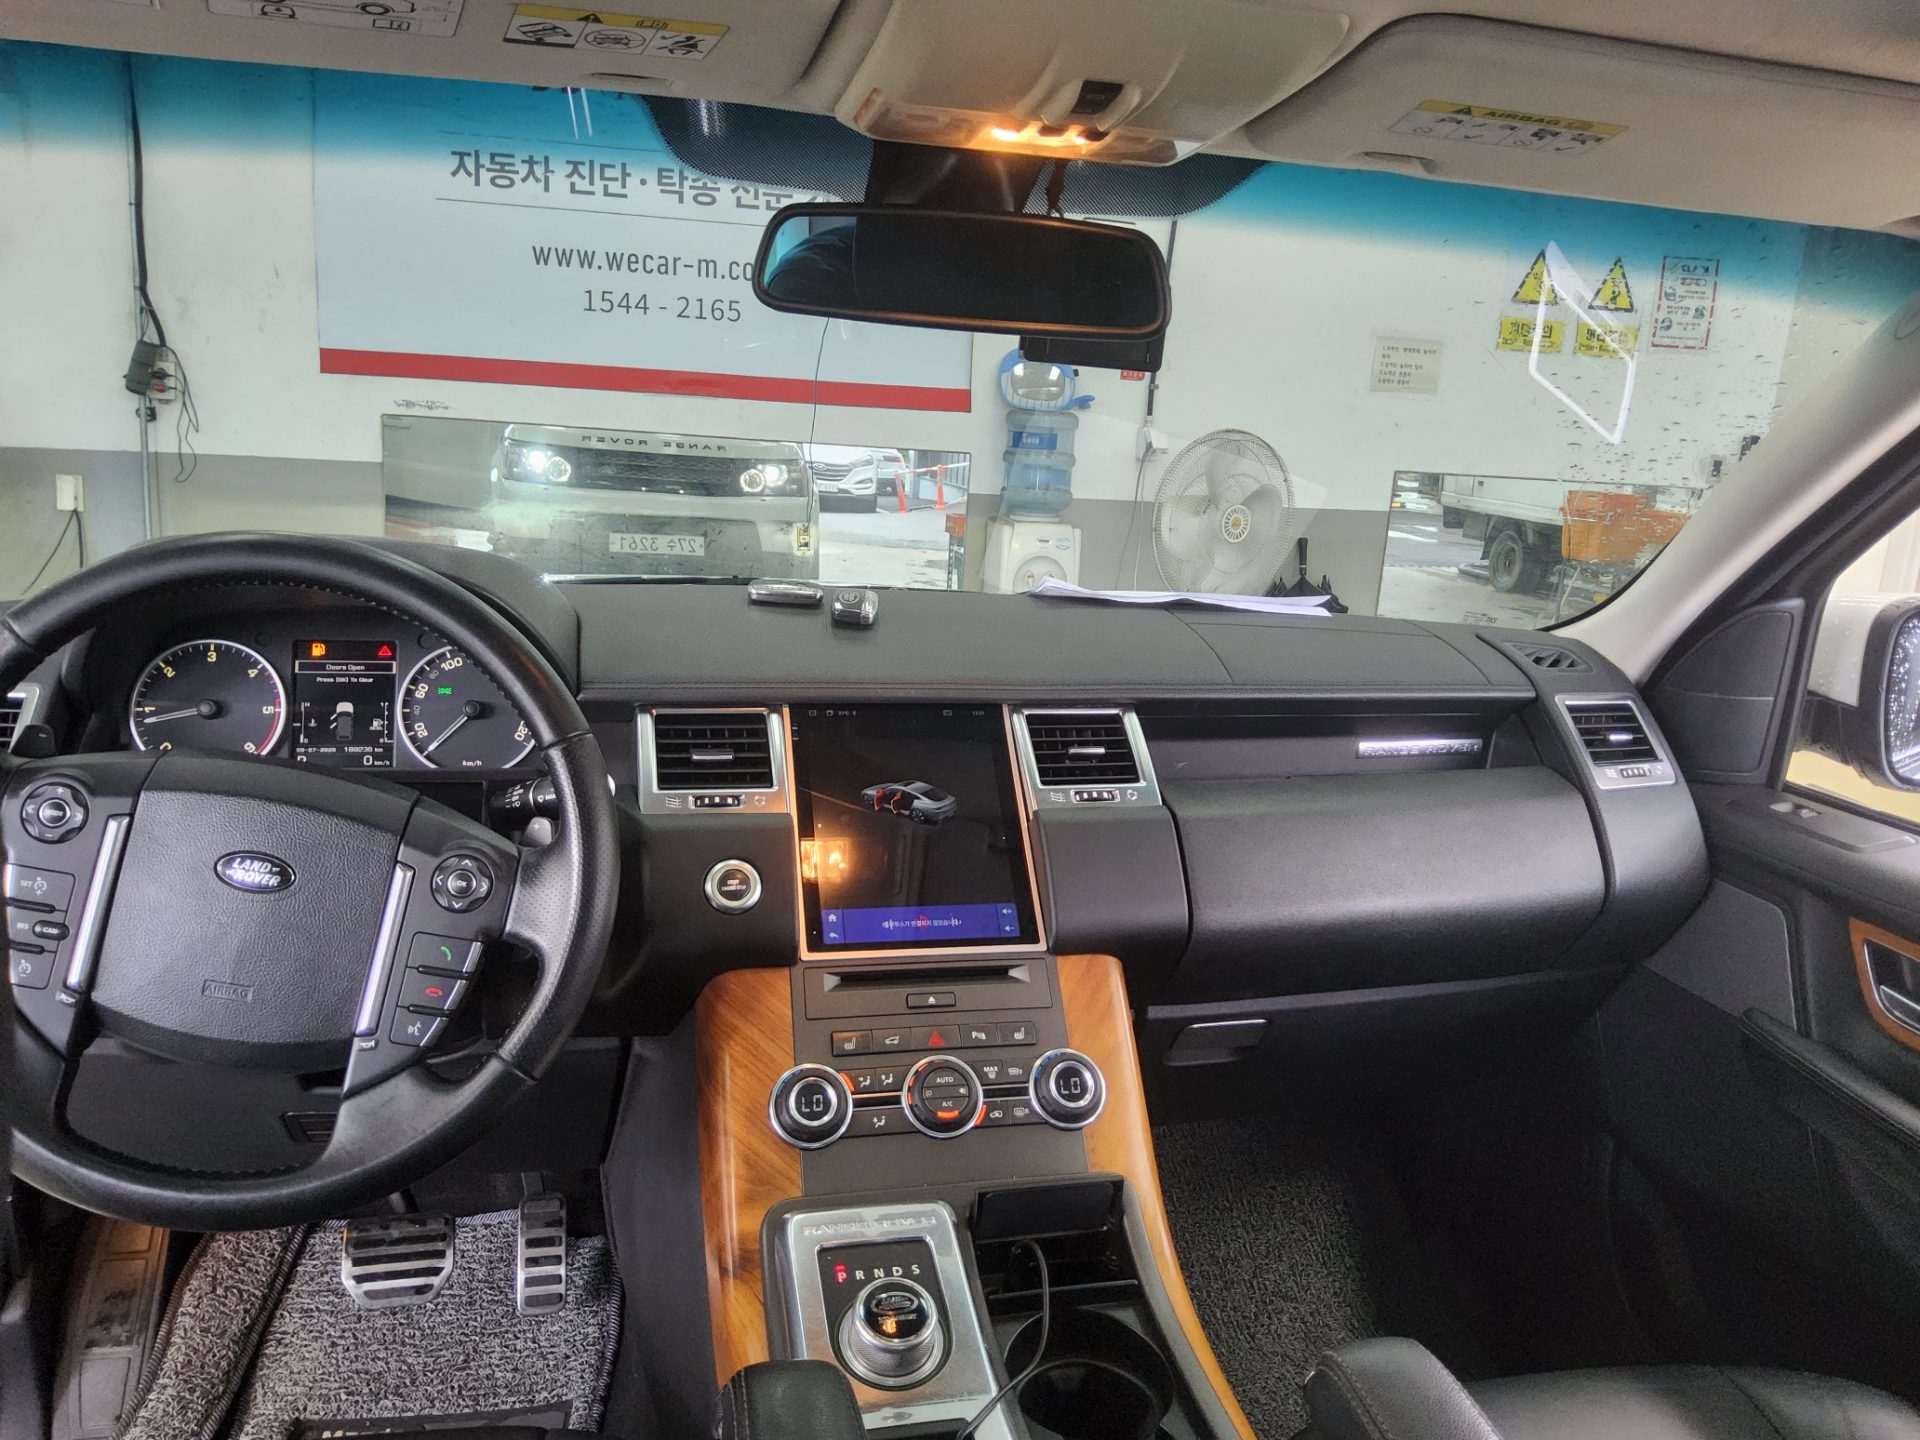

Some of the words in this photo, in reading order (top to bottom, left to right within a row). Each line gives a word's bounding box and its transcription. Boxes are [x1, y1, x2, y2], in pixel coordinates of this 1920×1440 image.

[450, 149, 555, 193] 자동차
[532, 244, 754, 282] www.wecar-m.co
[583, 289, 650, 316] 1544
[676, 295, 742, 322] 2165
[207, 651, 217, 662] 3
[440, 657, 464, 671] 100
[163, 666, 176, 678] 2
[247, 668, 259, 678] 4
[347, 663, 366, 673] Open
[415, 683, 429, 699] 60
[262, 705, 274, 715] 5
[414, 722, 429, 738] 20
[363, 754, 373, 766] 0
[231, 857, 272, 873] LAND
[232, 868, 282, 887] ROVER
[1060, 1077, 1081, 1095] LO
[801, 1093, 824, 1113] LO
[837, 1271, 848, 1283] P
[855, 1270, 866, 1280] R
[873, 1268, 885, 1278] N
[892, 1266, 903, 1277] D
[911, 1264, 921, 1275] S
